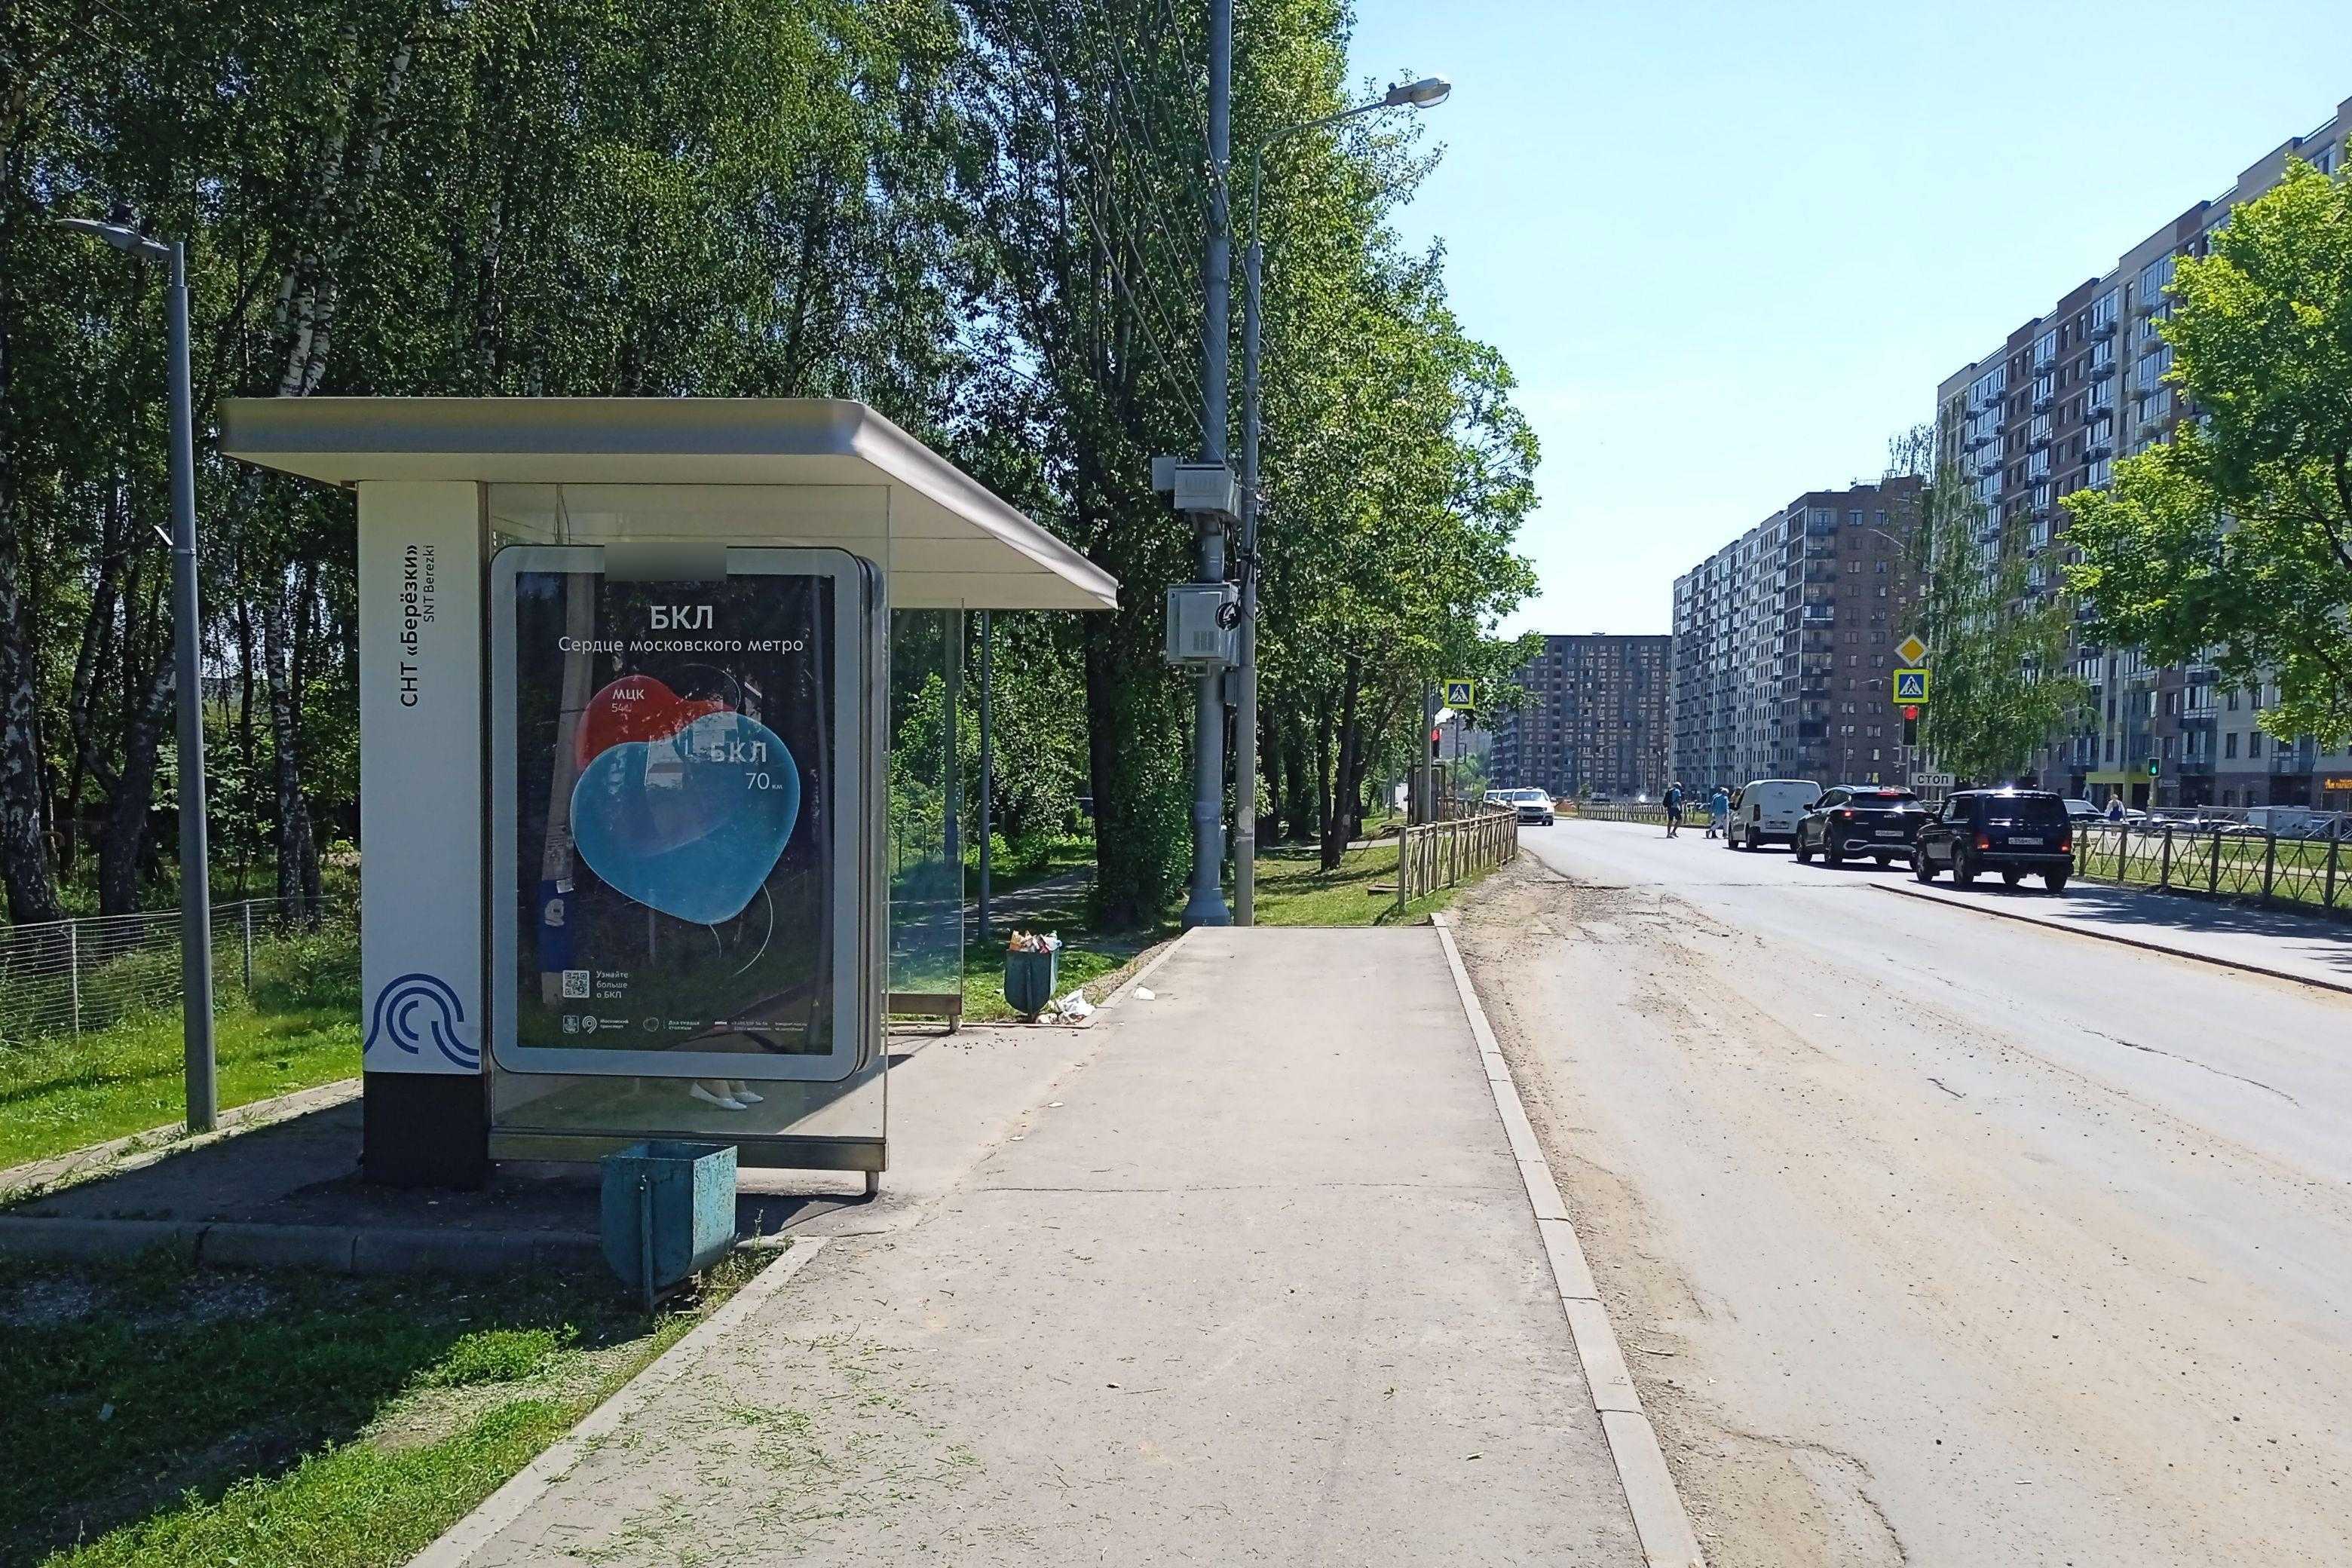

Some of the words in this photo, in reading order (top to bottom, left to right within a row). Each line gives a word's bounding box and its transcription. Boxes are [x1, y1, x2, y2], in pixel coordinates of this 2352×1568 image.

[423, 545, 434, 593] Berezki
[400, 544, 421, 657] «Берёзки»
[423, 596, 434, 623] SNT
[650, 605, 713, 629] БКЛ
[559, 636, 624, 655] Сердце
[629, 639, 742, 652] московского
[747, 639, 804, 655] метро
[400, 661, 418, 707] СНТ
[612, 688, 645, 701] МЦК
[711, 741, 767, 762] БКЛ
[746, 773, 770, 790] 70
[1917, 775, 1949, 784] СТОП
[596, 970, 629, 978] Узнайте
[596, 980, 628, 988] больше
[604, 991, 622, 999] БКЛ
